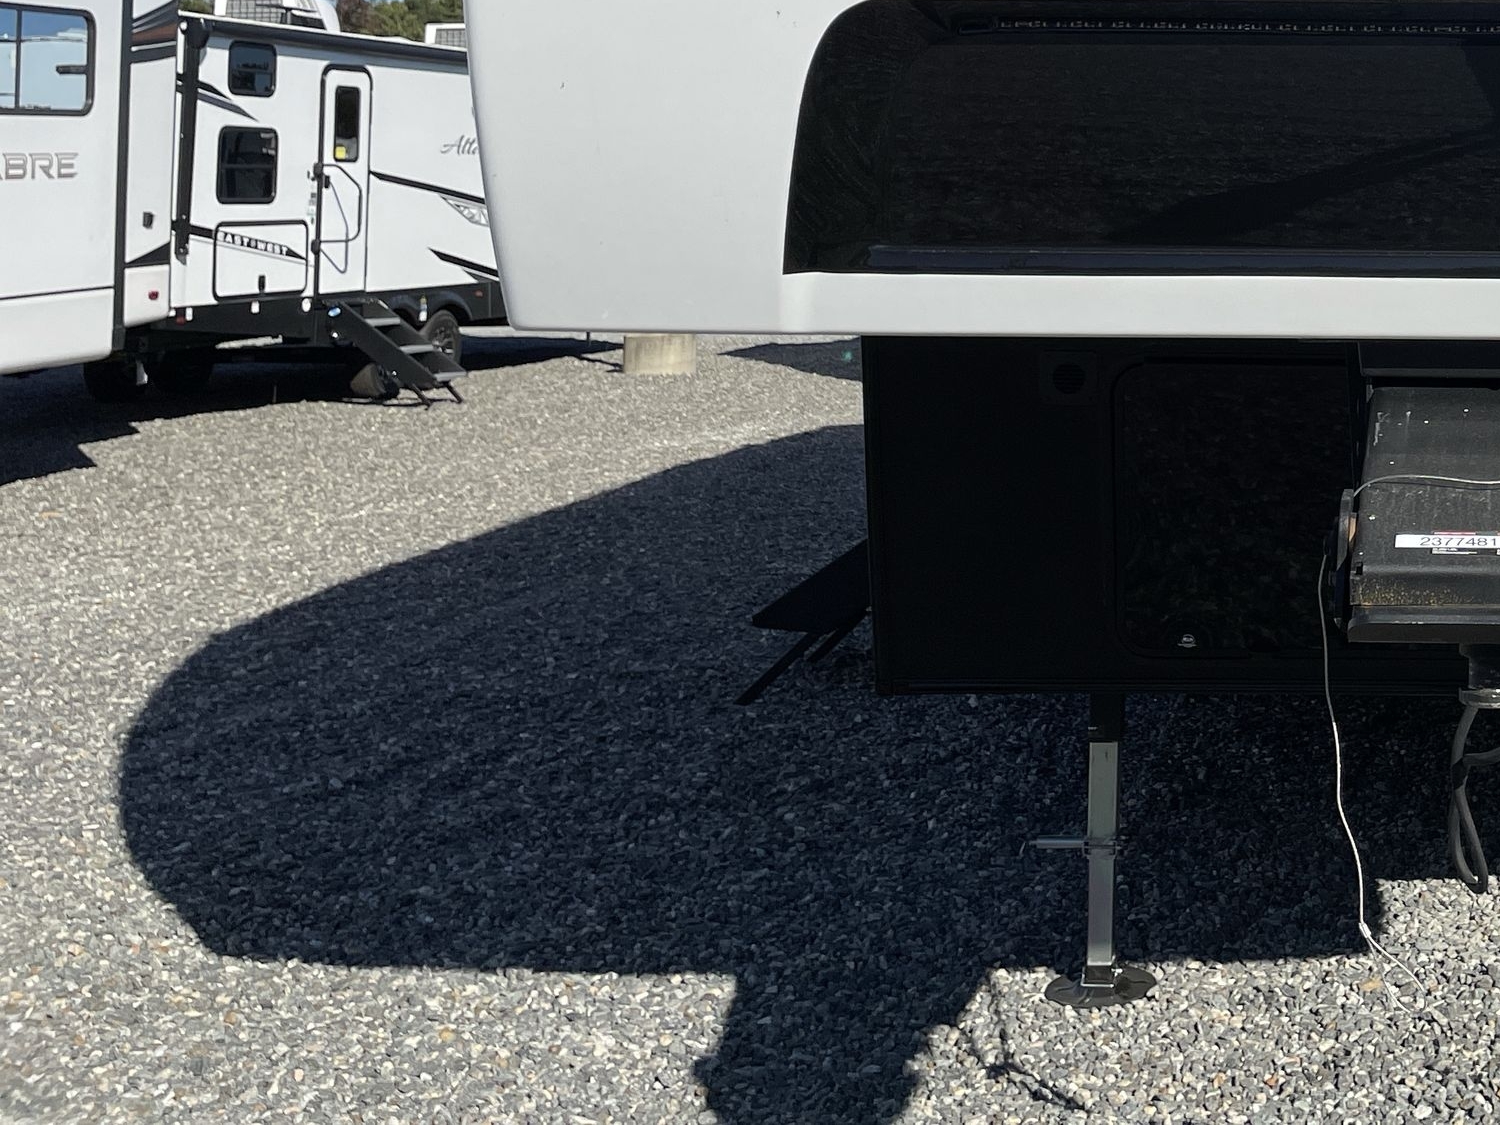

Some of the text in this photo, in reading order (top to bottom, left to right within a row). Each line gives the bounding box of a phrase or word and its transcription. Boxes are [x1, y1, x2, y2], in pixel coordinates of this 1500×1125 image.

[0, 152, 79, 180] BRE
[217, 231, 288, 256] EAST WEST
[1419, 536, 1497, 547] 2377481
